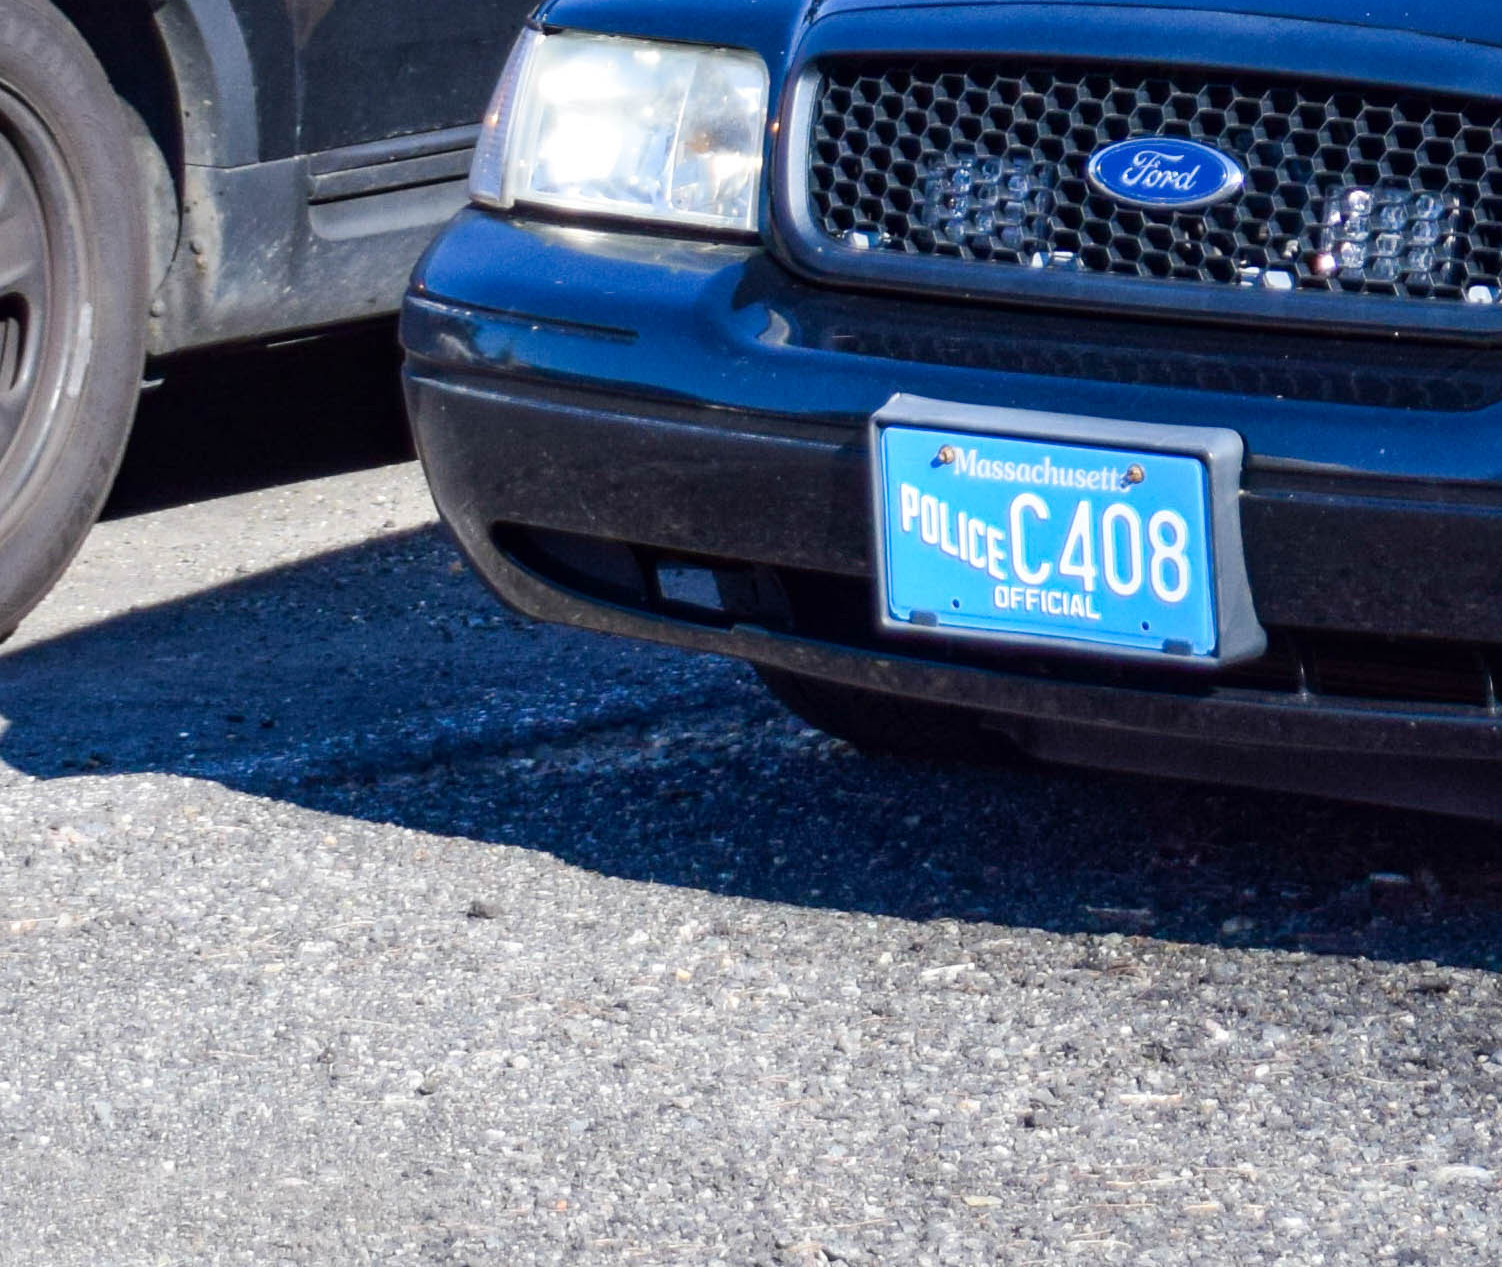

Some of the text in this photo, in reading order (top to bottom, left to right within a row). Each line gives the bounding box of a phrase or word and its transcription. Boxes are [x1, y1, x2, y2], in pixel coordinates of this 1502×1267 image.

[1121, 149, 1201, 191] Ford
[899, 482, 1190, 604] POLICE C408
[993, 585, 1101, 621] OFFICIAL
